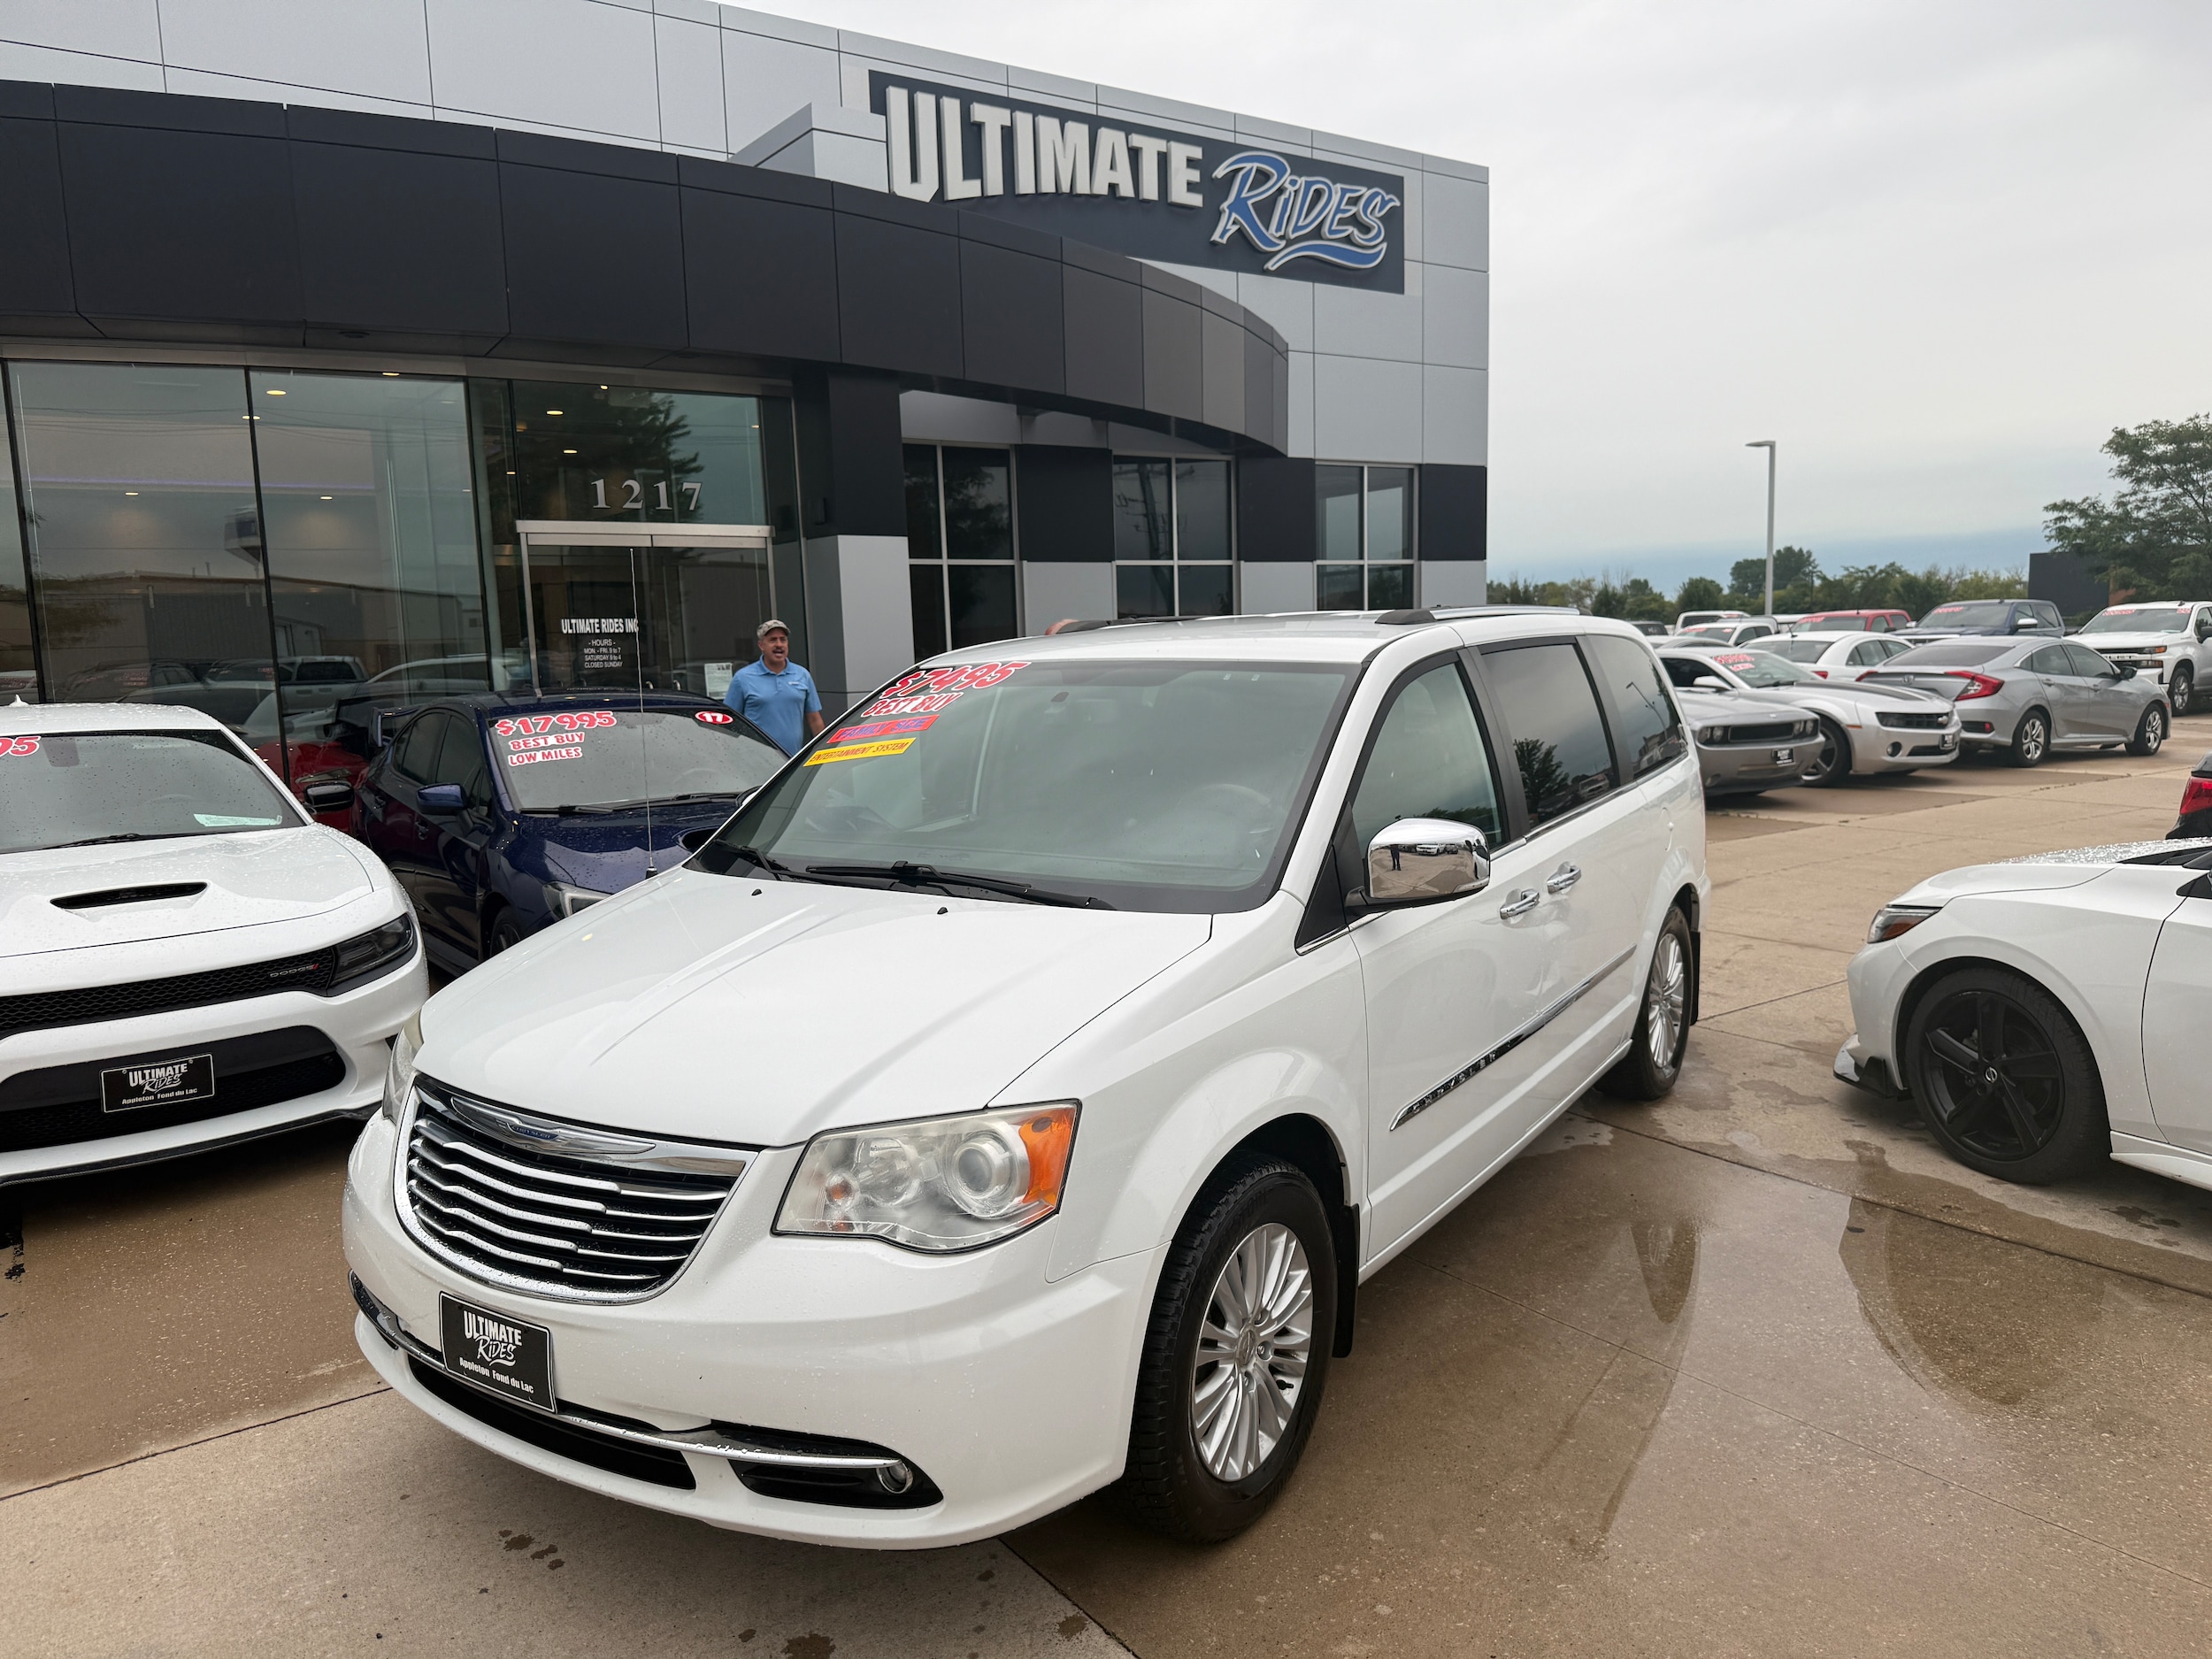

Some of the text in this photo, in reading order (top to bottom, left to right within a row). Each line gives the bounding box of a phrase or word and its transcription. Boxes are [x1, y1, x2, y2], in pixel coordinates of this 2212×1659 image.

[886, 85, 1203, 208] ULTIMATE
[590, 478, 703, 511] 1217
[561, 618, 601, 634] ULTIMATE
[602, 618, 625, 634] RIDES
[591, 638, 613, 647] HOURS
[879, 661, 1033, 699] $7495
[861, 692, 964, 718] BEST BUY
[495, 710, 618, 736] $17995
[702, 711, 724, 724] 17
[835, 717, 930, 740] FAMILY SIZE
[508, 732, 586, 751] BEST BUY
[809, 741, 910, 762] ENTERTAINMENT SYSTEM
[508, 747, 583, 767] LOW MILES
[270, 964, 314, 978] DODGE
[128, 1063, 188, 1087] ULTIMATE
[122, 1094, 155, 1105] Appleton
[463, 1310, 523, 1347] ULTIMATE
[459, 1356, 534, 1394] Appleton Fond du Lac
